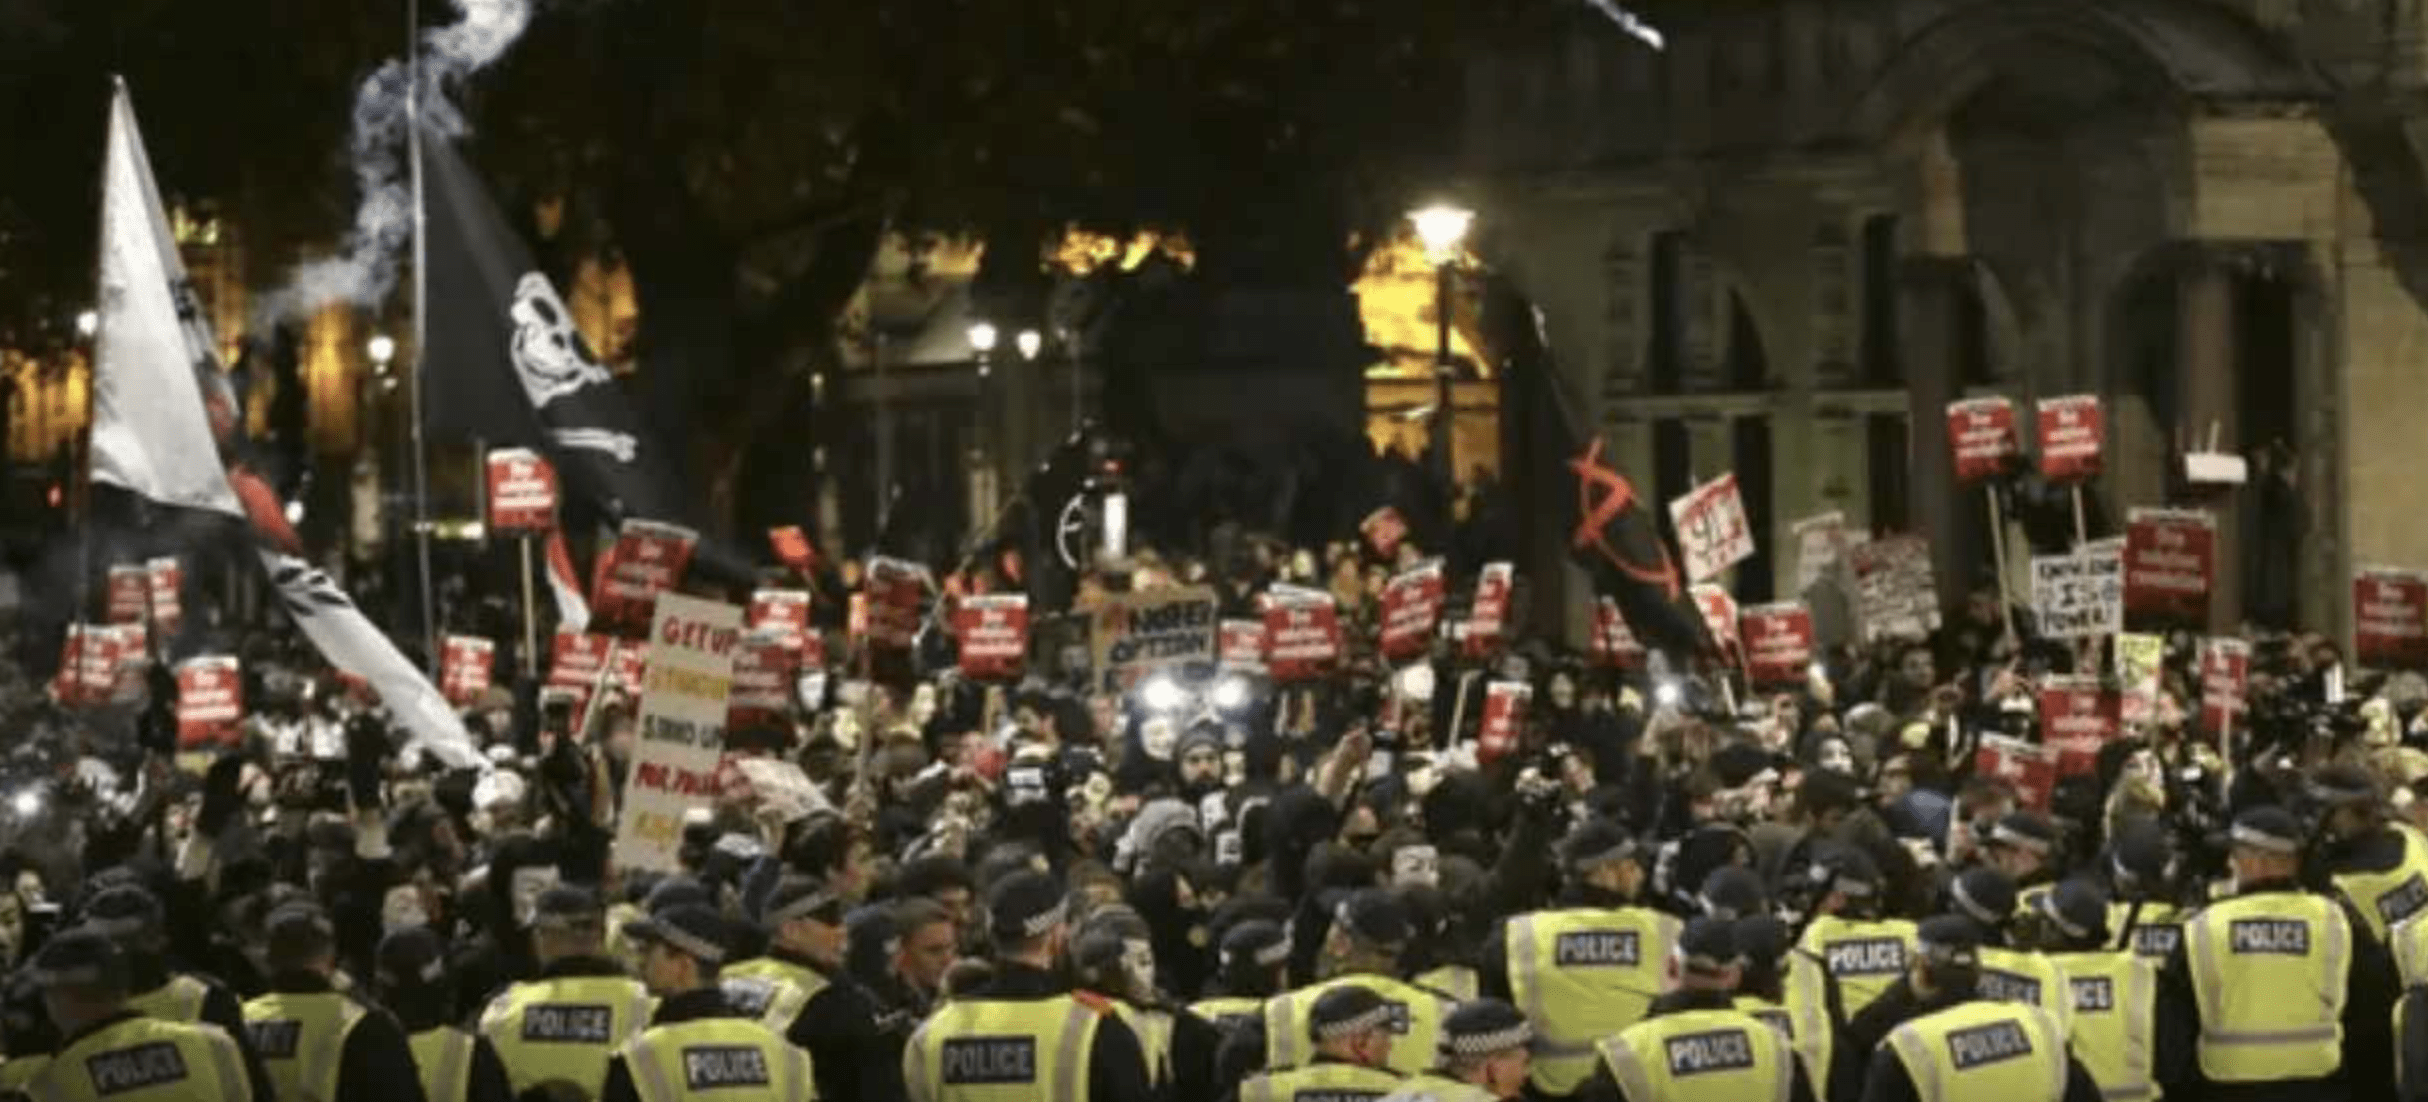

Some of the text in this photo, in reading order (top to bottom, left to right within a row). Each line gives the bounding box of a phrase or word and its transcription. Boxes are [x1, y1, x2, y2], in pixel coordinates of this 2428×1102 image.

[1560, 934, 1635, 962] POLICE
[2236, 922, 2304, 950] POLICE
[1829, 943, 1902, 972] POLICE
[525, 1008, 607, 1037] POLICE
[1669, 1033, 1749, 1070] POLICE
[1951, 1020, 2030, 1066] POLICE
[687, 1050, 766, 1084] POLICE
[944, 1043, 1032, 1077] POLICE
